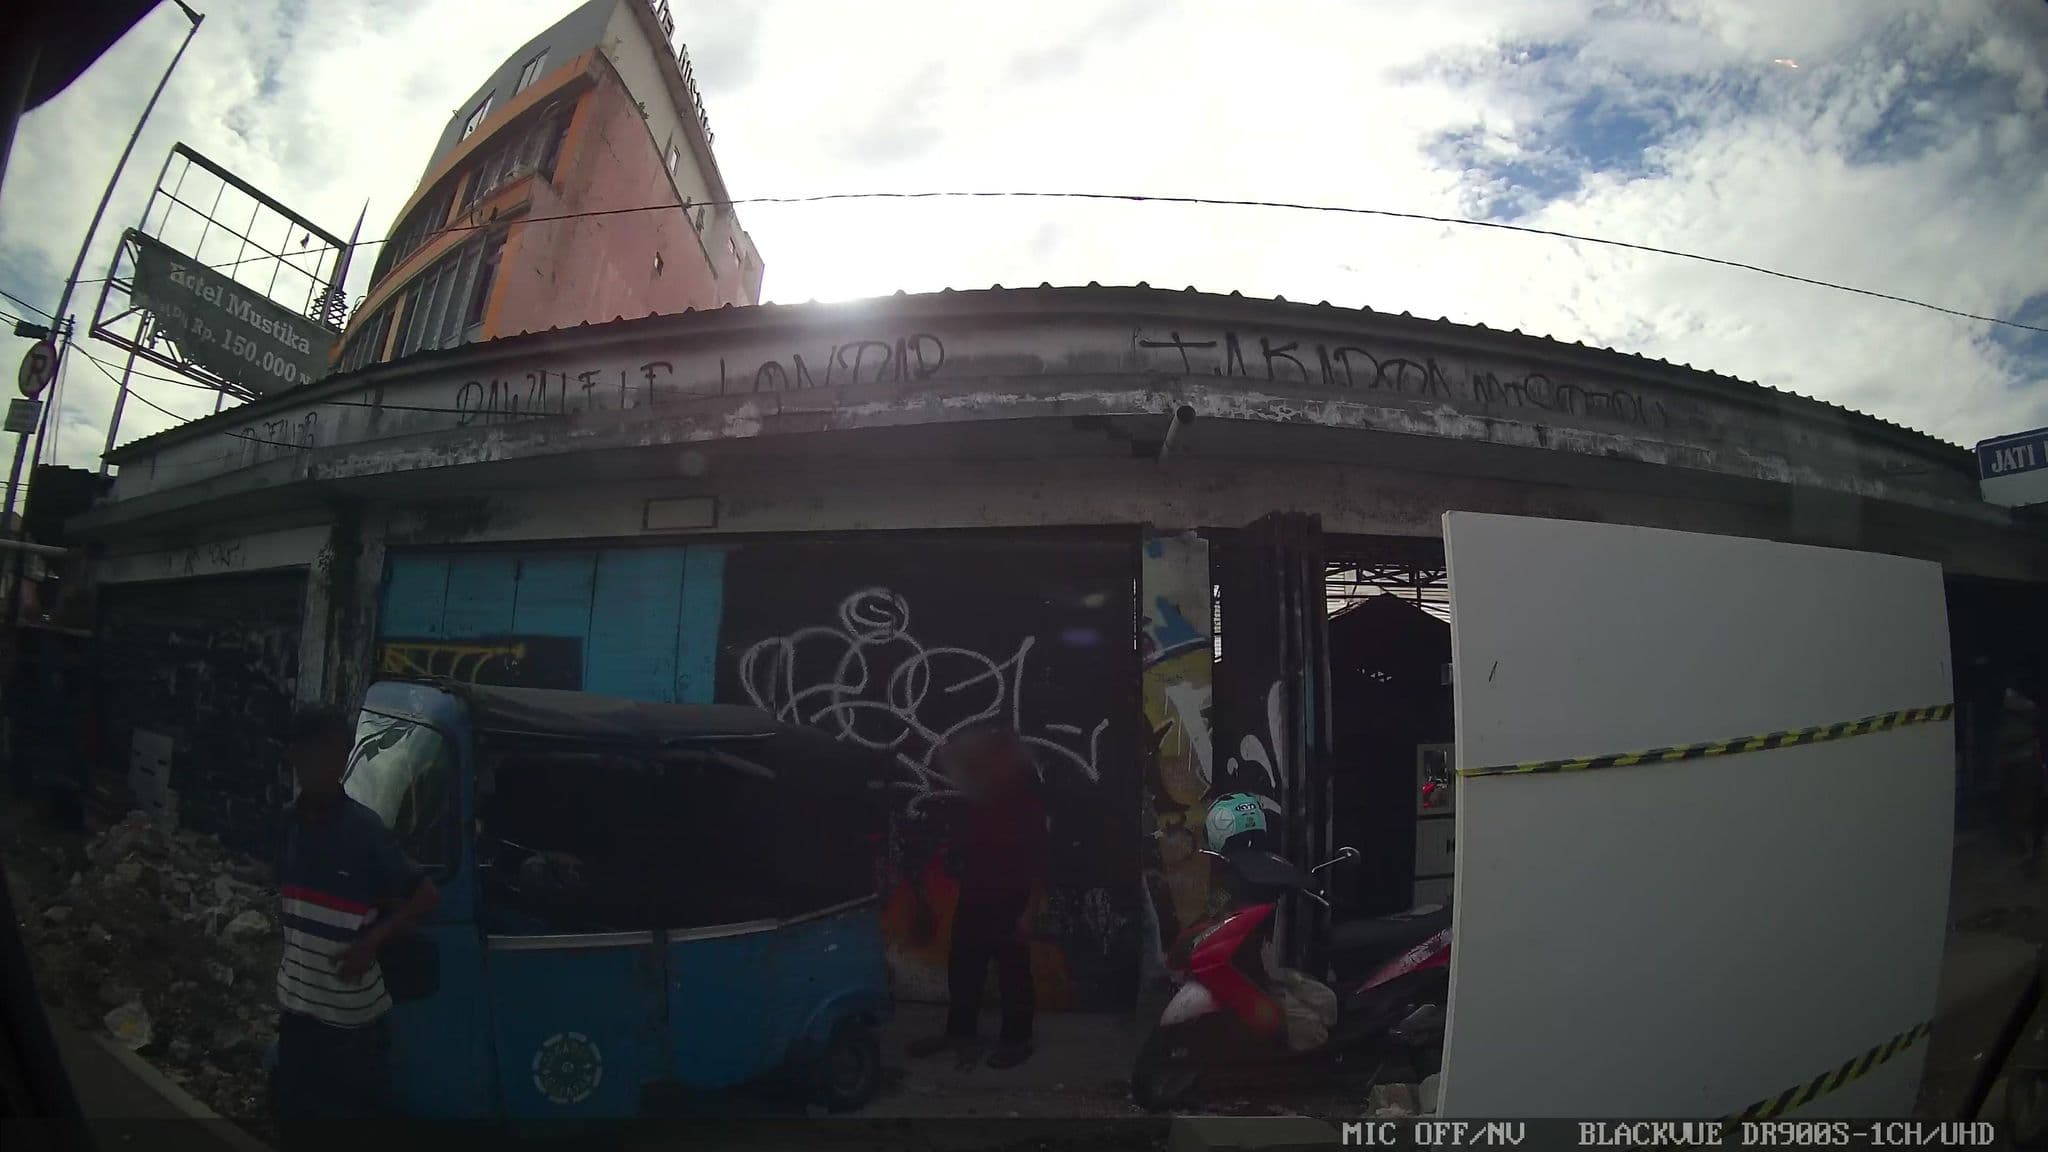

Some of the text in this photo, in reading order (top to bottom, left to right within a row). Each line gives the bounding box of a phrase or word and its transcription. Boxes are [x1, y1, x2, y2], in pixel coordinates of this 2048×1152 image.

[225, 292, 311, 355] Mustika
[219, 328, 297, 383] 150.000
[1991, 444, 2036, 473] JATI
